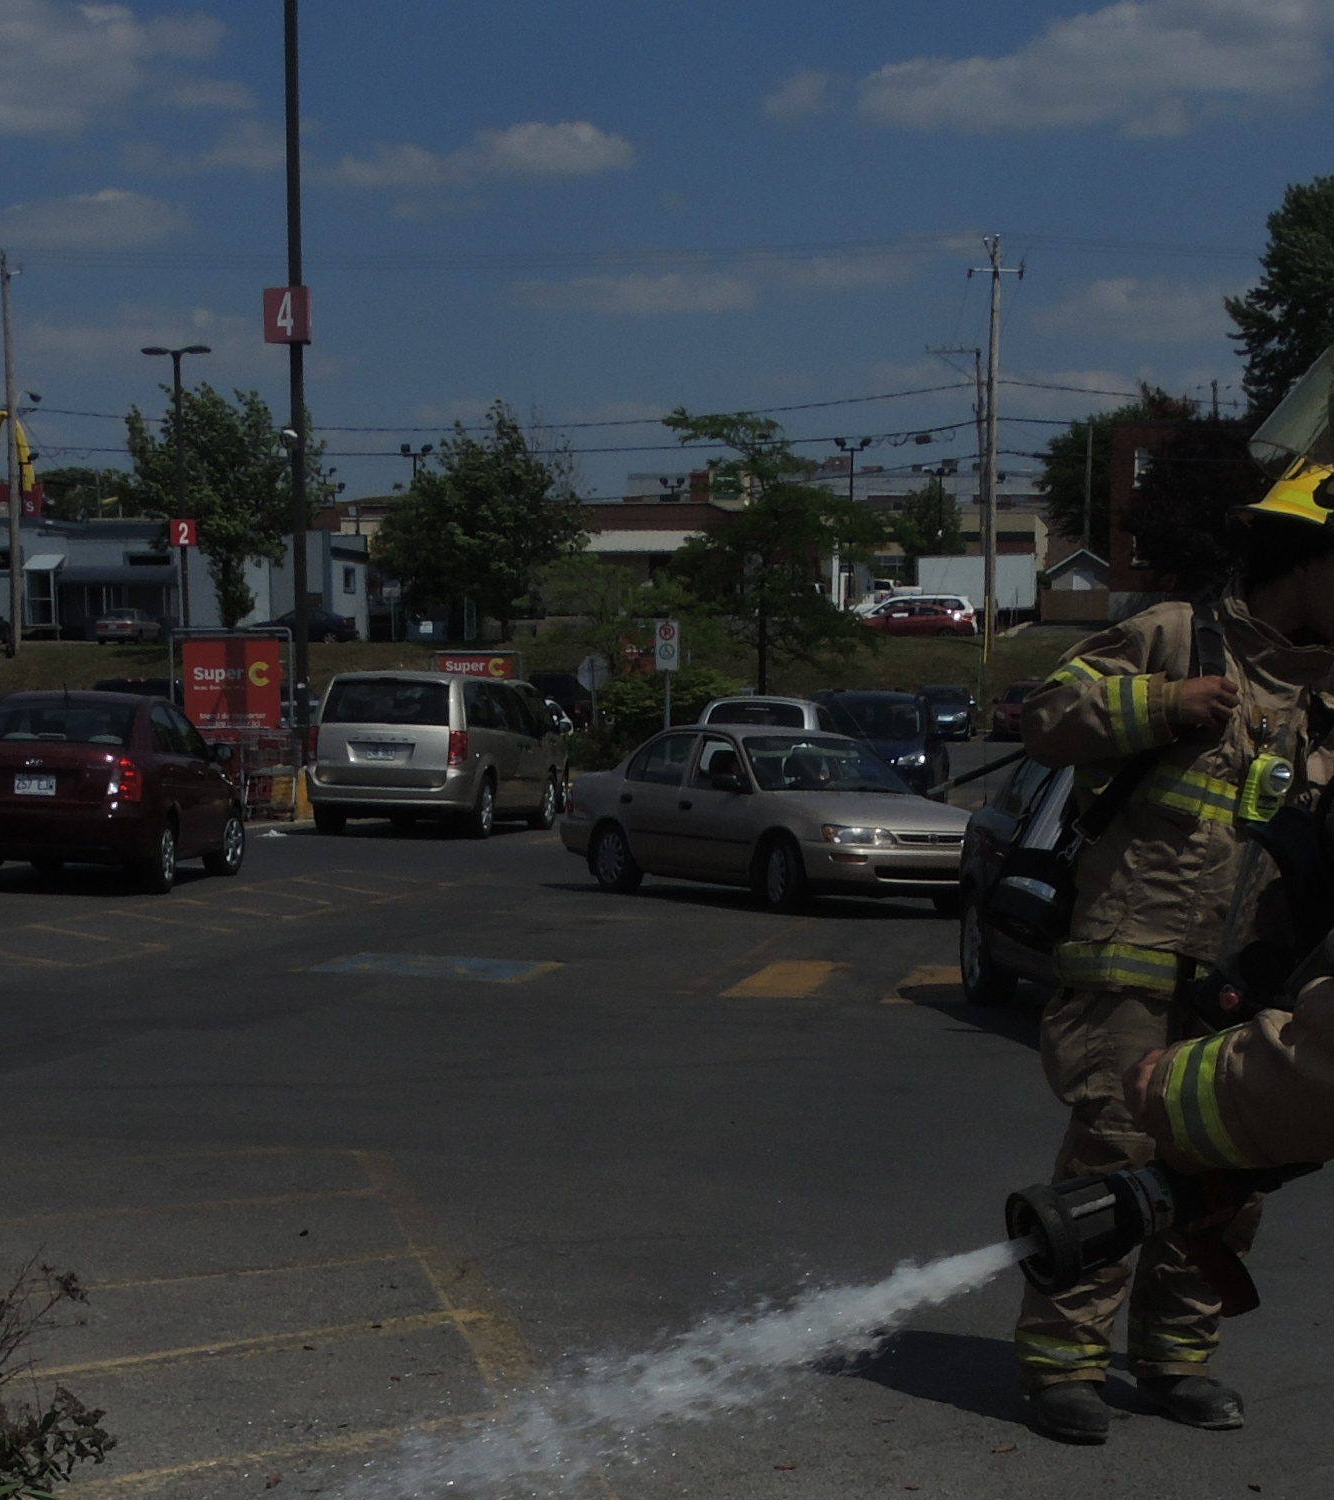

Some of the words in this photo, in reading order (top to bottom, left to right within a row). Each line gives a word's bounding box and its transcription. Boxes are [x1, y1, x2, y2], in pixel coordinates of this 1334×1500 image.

[277, 291, 294, 336] 4
[178, 522, 189, 544] 2
[193, 667, 244, 683] Super
[248, 661, 270, 687] C
[445, 660, 485, 674] Super
[488, 658, 505, 676] C
